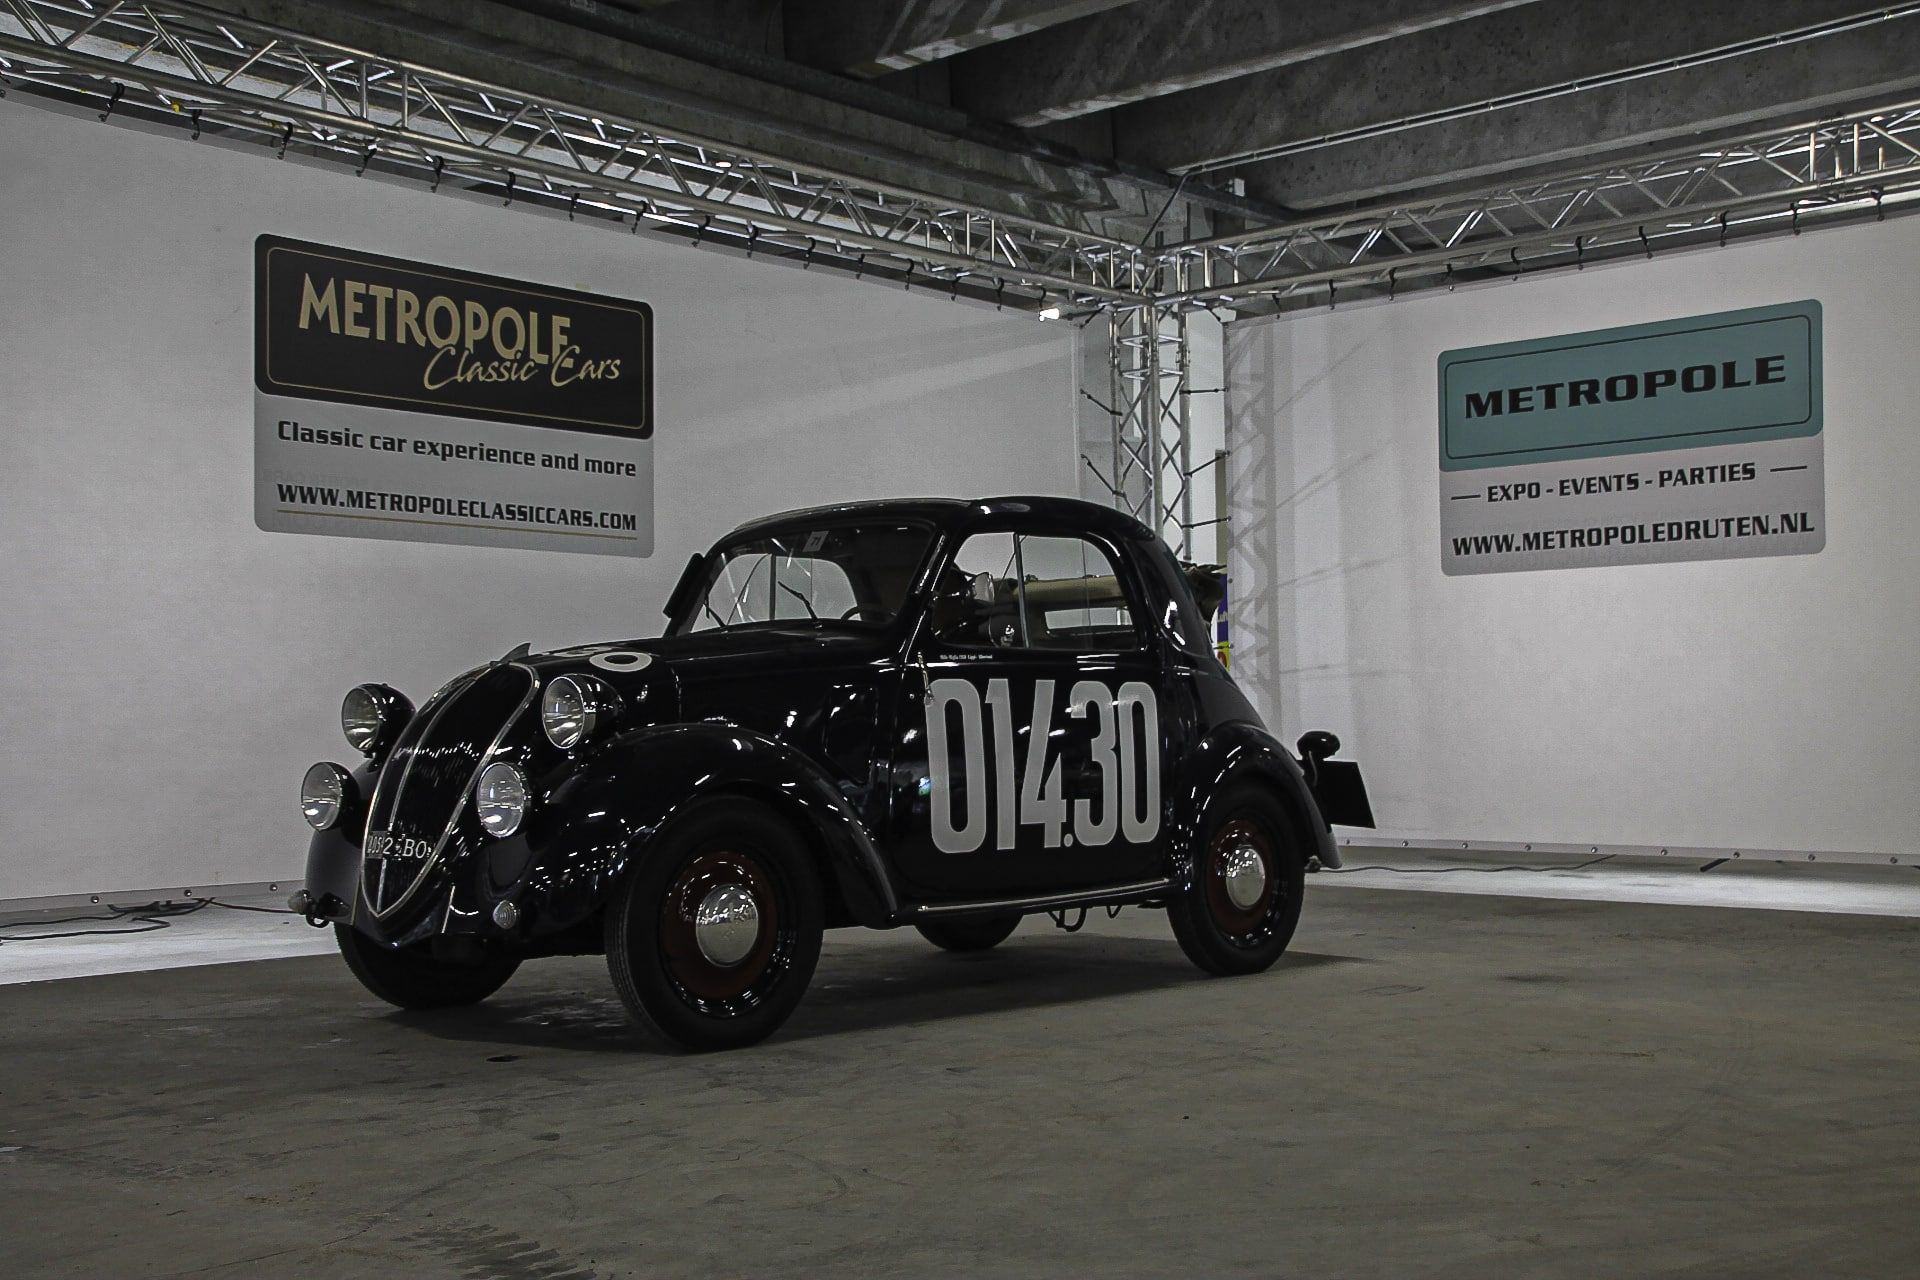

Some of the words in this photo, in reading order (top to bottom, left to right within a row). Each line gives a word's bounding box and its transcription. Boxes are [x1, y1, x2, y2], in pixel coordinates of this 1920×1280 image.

[299, 272, 573, 368] METROPOLE
[424, 347, 538, 391] Classic
[550, 345, 620, 387] Cars
[1465, 355, 1786, 419] METROPOLE
[277, 420, 364, 449] Classic
[369, 434, 407, 453] car
[413, 439, 536, 467] experience
[541, 452, 579, 472] and
[585, 458, 637, 477] more
[277, 484, 637, 531] WWW.METROPOLECLASSICCARS.COM
[1487, 481, 1541, 503] EXPO
[1558, 472, 1639, 497] EVENTS
[1658, 462, 1756, 488] PARTIES
[1452, 512, 1815, 556] WWW.METROPOLEDRUTEN.NL
[924, 678, 1161, 854] 014.30
